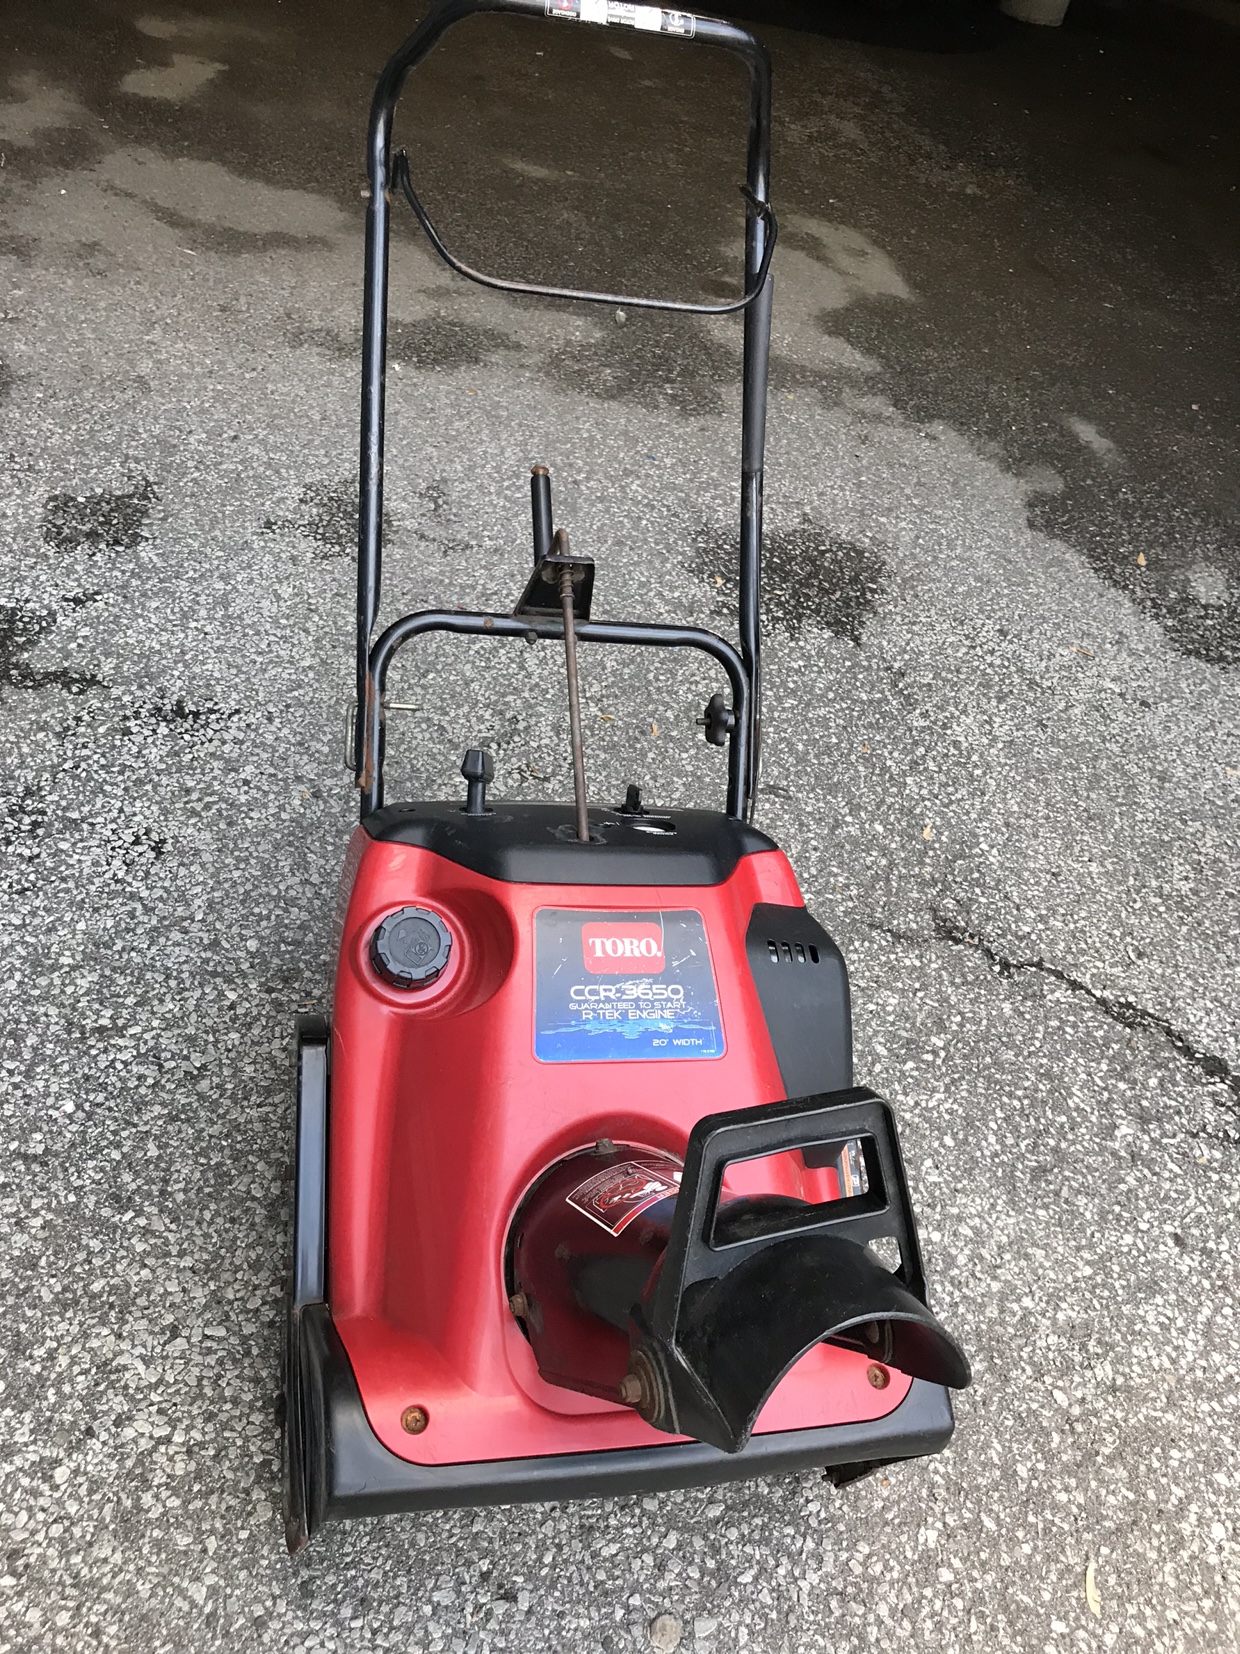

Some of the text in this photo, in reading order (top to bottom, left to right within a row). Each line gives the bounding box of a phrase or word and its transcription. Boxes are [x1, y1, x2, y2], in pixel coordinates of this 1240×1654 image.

[569, 1001, 636, 1010] GUARANTEED
[654, 1000, 687, 1009] START
[628, 1009, 676, 1020] ENGINE
[672, 1038, 703, 1046] WIDTH
